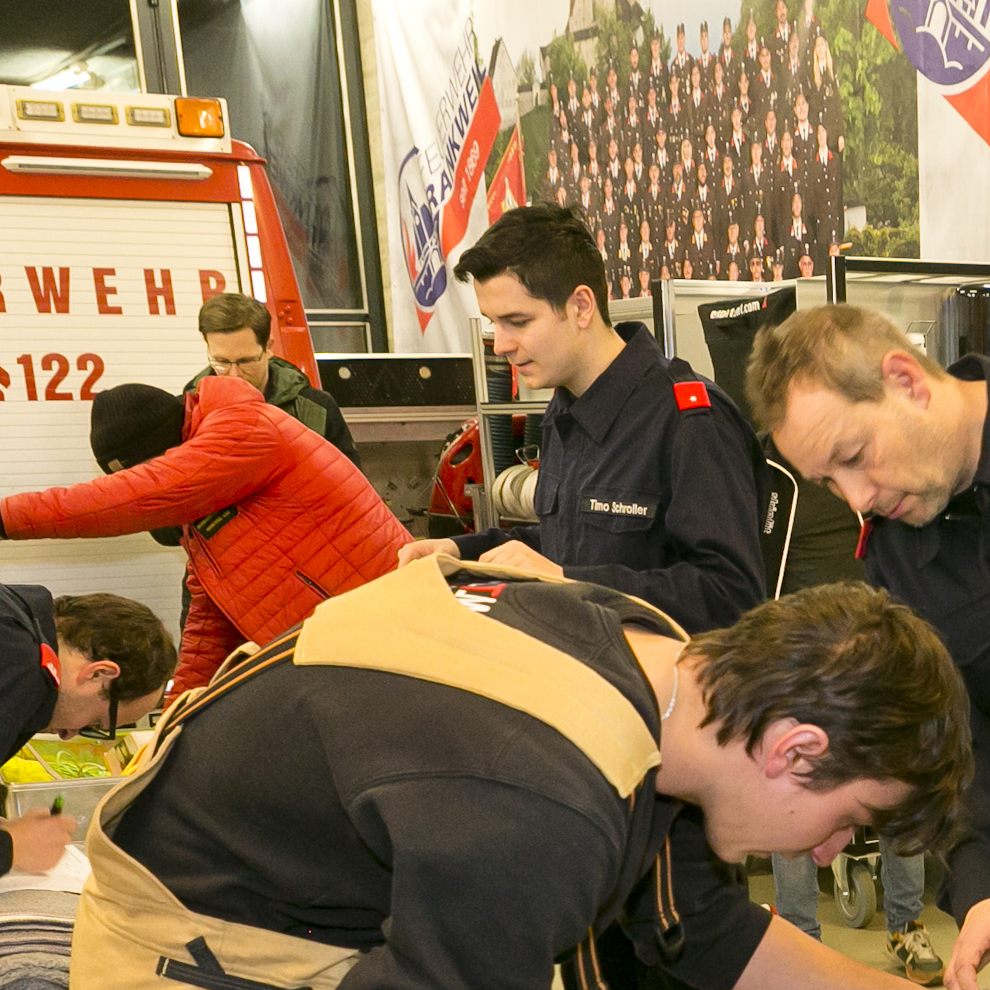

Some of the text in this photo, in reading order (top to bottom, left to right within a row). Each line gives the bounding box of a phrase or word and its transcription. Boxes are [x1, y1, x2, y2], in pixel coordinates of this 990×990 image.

[0, 266, 226, 315] WEHR
[16, 352, 105, 401] 122
[590, 499, 609, 512] Timo
